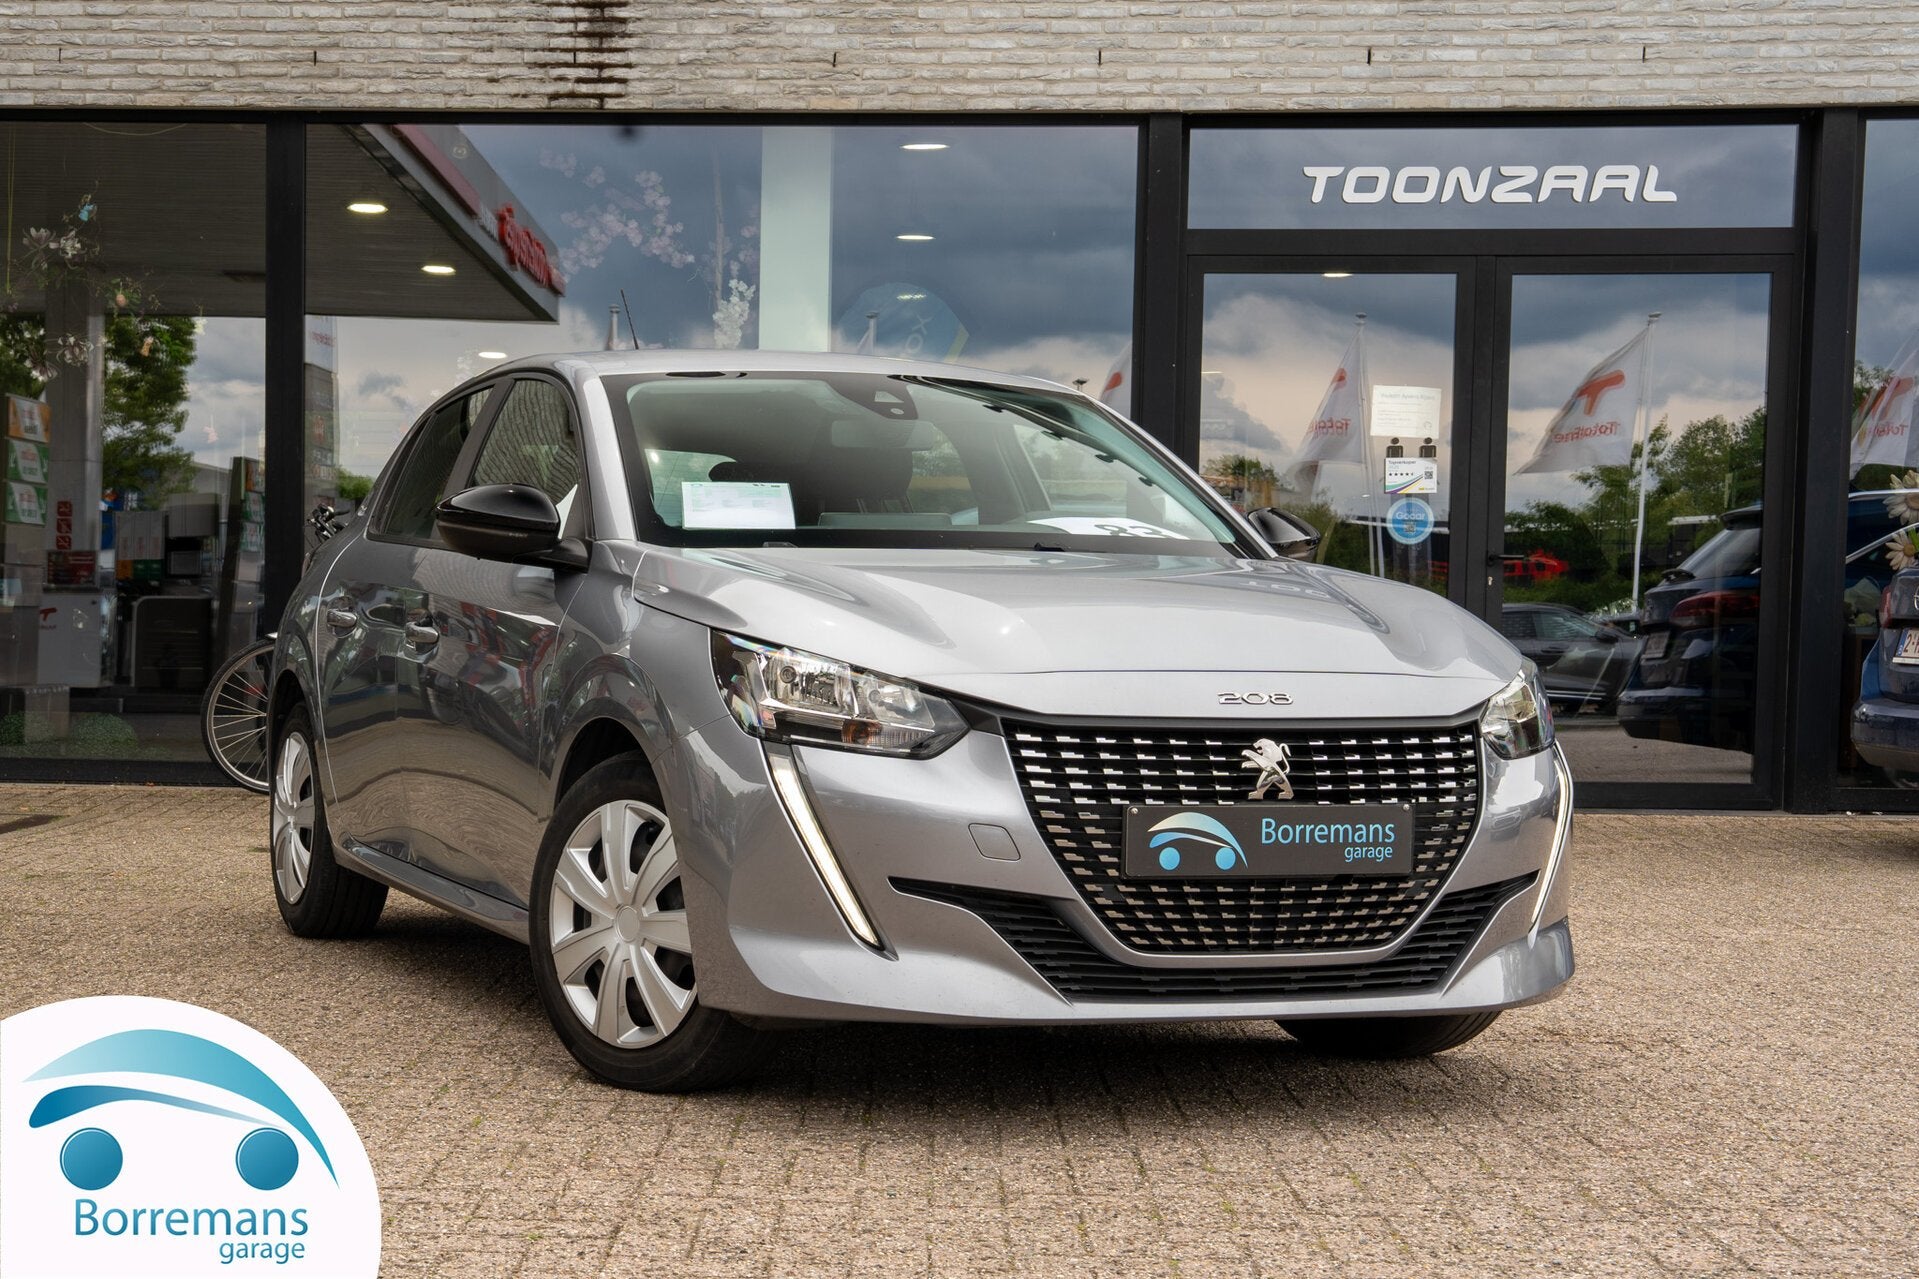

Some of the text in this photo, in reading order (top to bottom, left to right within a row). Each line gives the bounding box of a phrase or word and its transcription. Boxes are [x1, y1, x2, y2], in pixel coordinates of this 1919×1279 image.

[1303, 165, 1677, 203] TOONZAAL
[1217, 691, 1294, 705] 208
[1261, 818, 1395, 844] Borremans
[1344, 846, 1393, 862] garage
